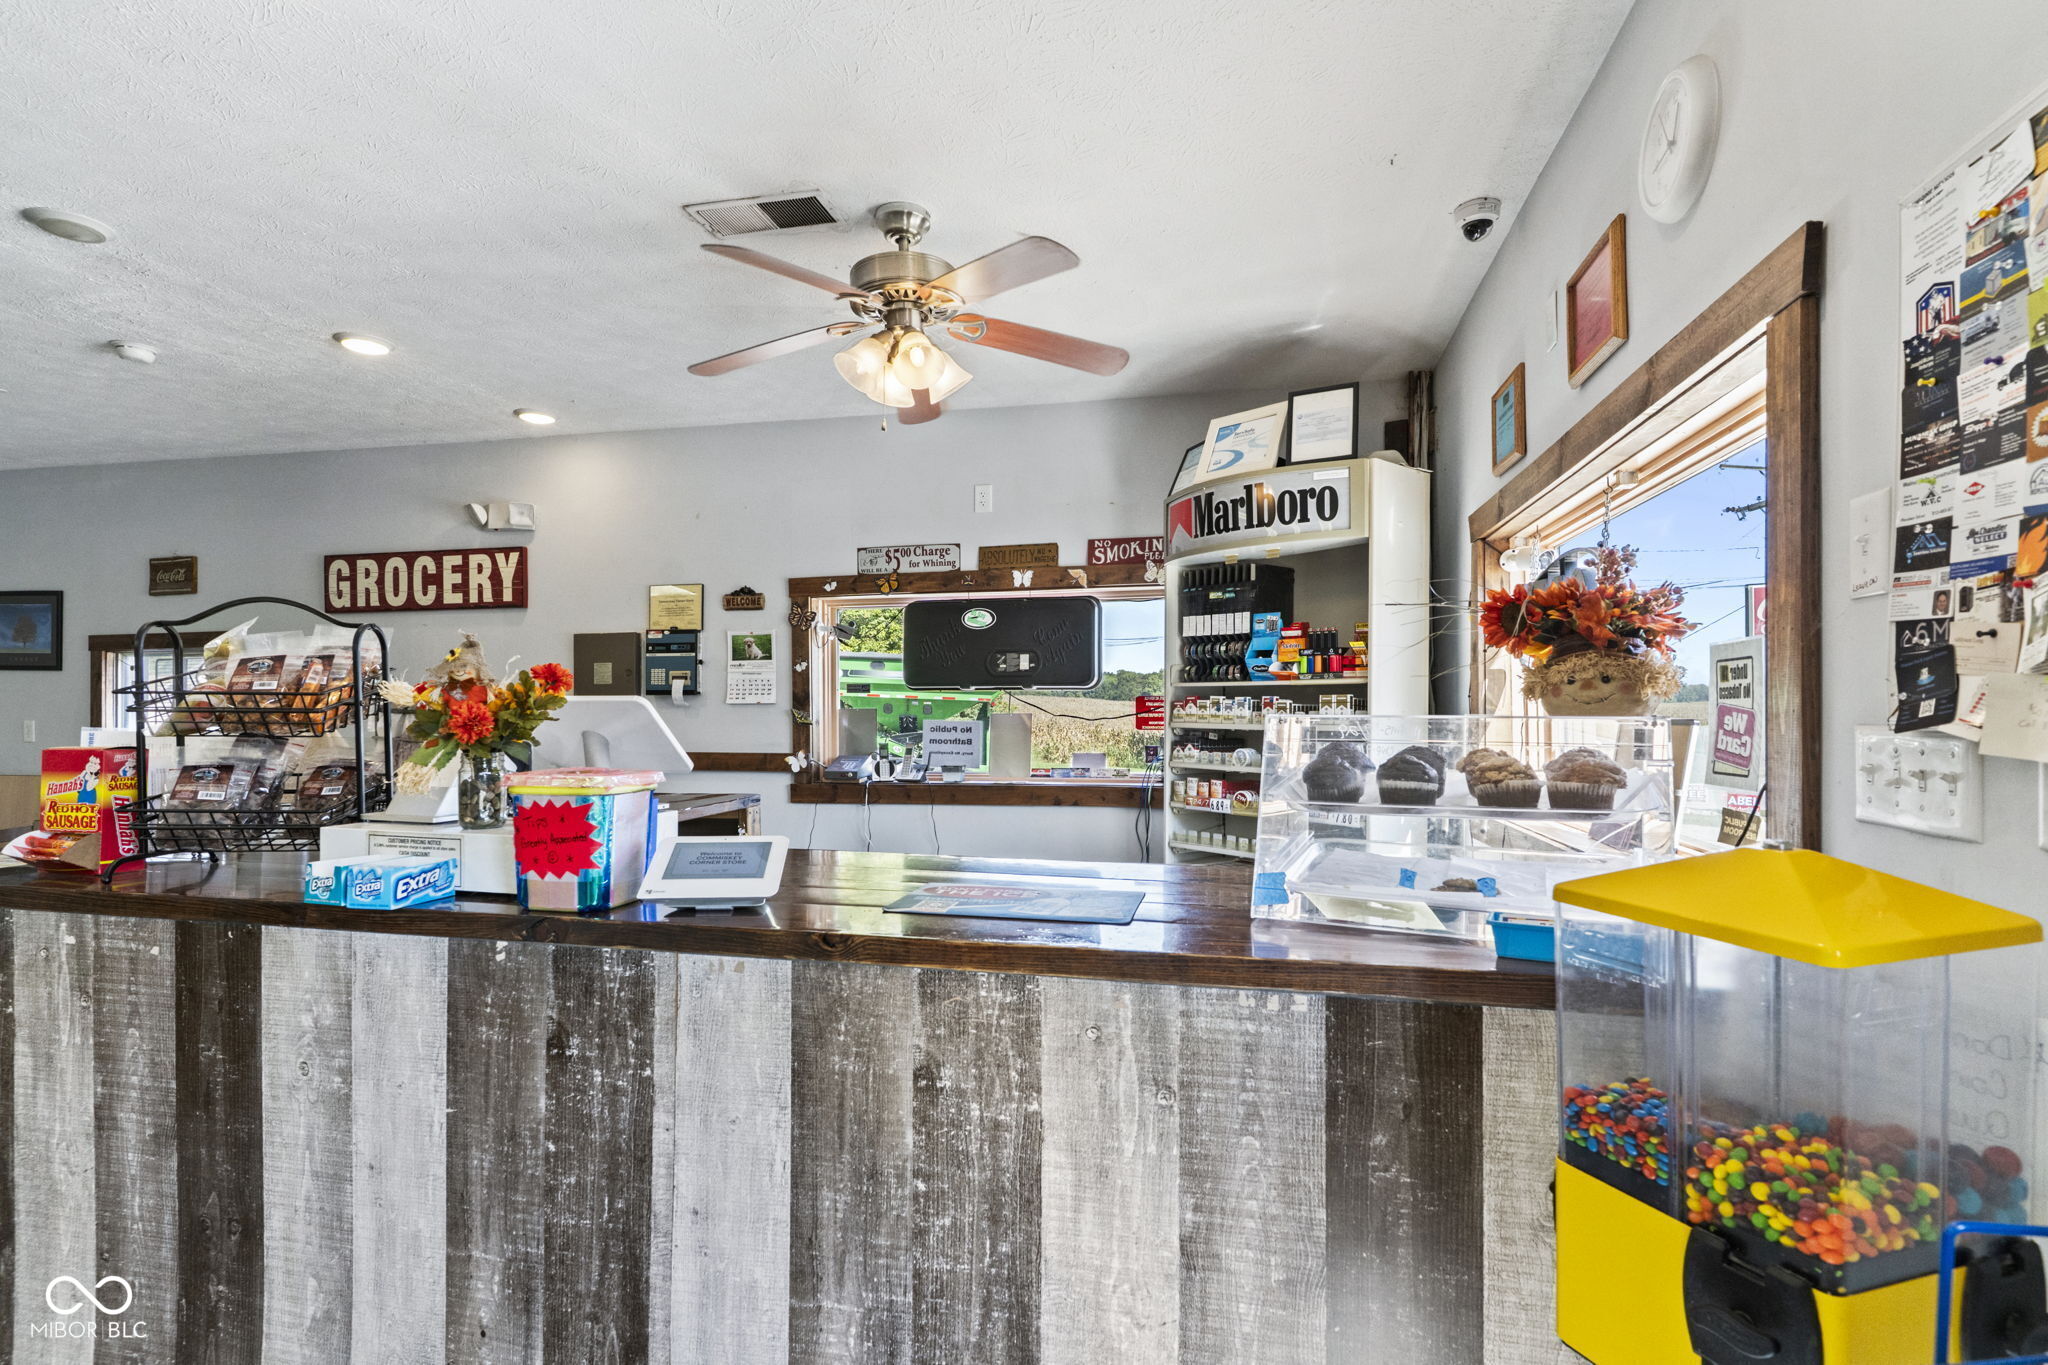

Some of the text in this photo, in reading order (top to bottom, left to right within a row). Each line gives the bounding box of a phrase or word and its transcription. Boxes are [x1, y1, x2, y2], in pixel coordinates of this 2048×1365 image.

[1193, 482, 1339, 539] Marlboro
[1092, 538, 1163, 564] SMOKIN
[1094, 540, 1110, 548] NO
[913, 545, 951, 559] Charge
[982, 549, 1035, 567] ABSOLUTELY
[909, 560, 920, 568] for
[923, 559, 956, 569] Whining
[328, 552, 520, 608] GROCERY
[725, 597, 761, 606] WELCOME
[47, 776, 84, 796] Hannah's
[46, 815, 96, 828] SAUSAGE
[522, 816, 547, 829] Tips
[311, 876, 334, 891] Extra
[355, 881, 382, 896] Extra
[395, 868, 440, 900] Extra
